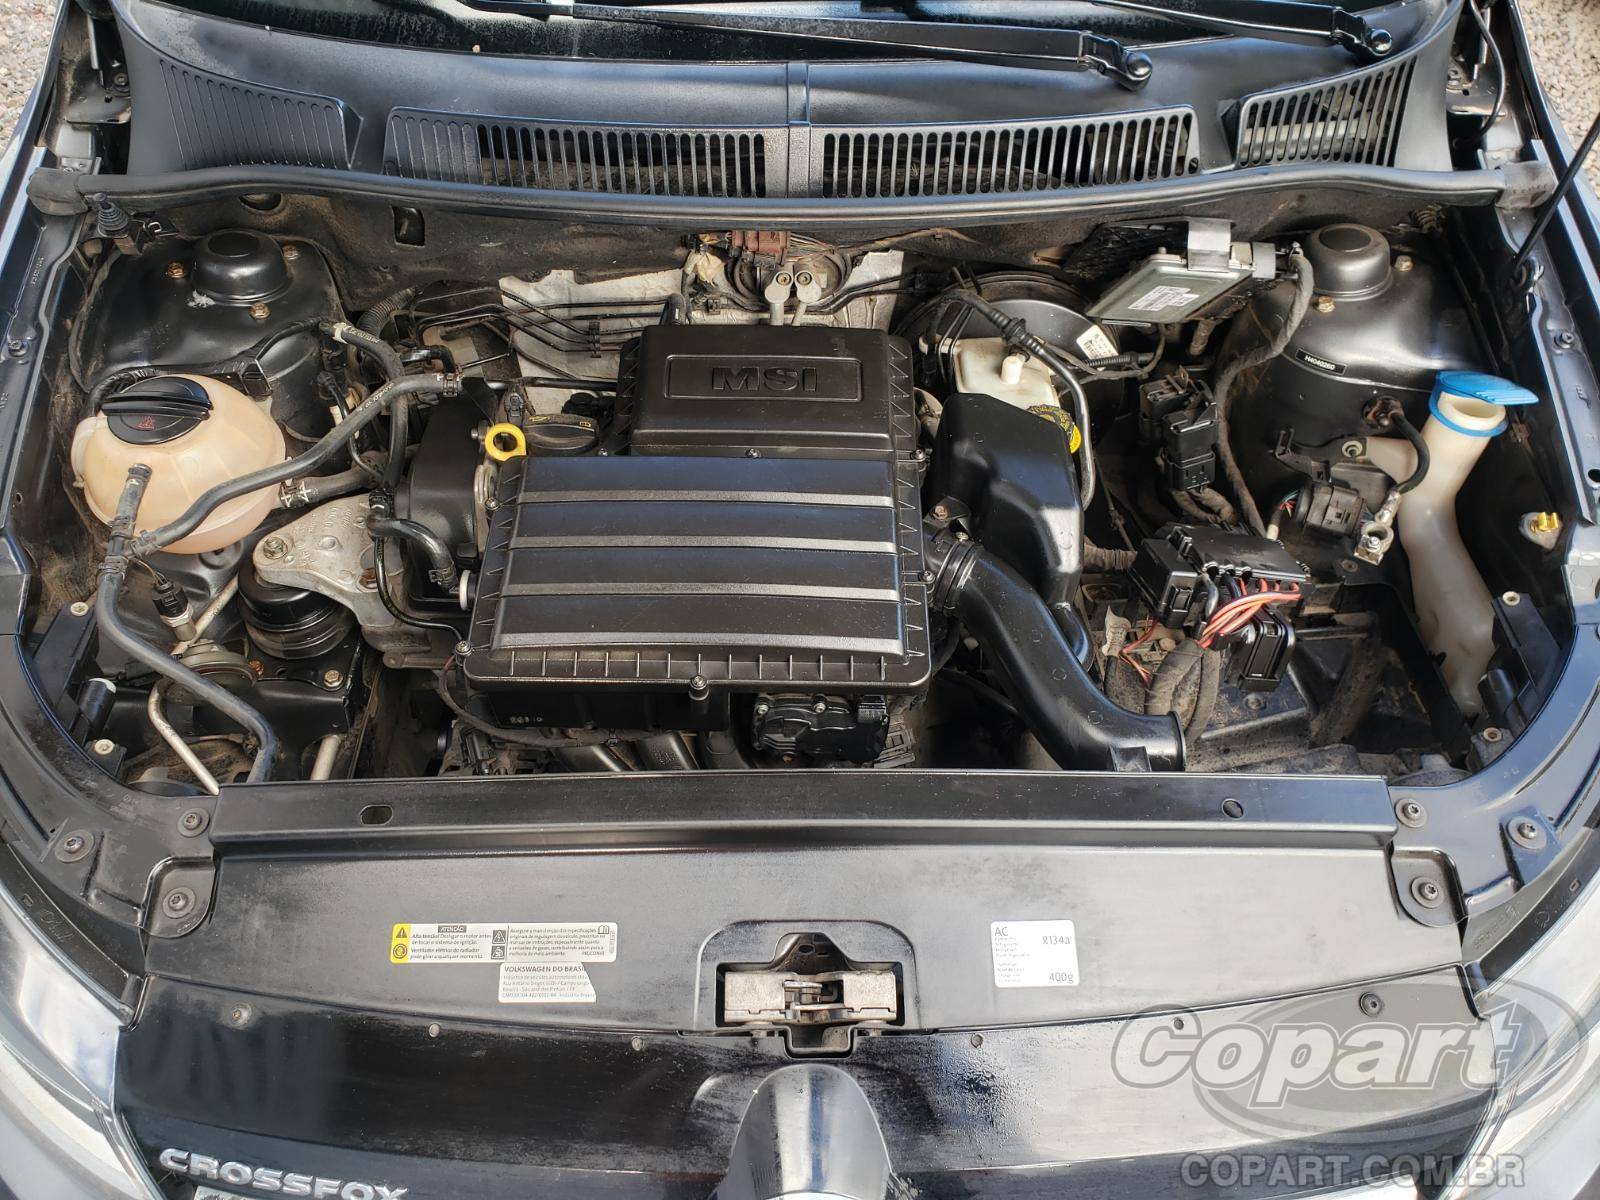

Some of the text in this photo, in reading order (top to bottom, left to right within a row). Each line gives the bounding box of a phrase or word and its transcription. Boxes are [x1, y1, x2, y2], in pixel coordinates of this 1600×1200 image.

[711, 366, 818, 391] MSI
[994, 927, 1008, 937] AC
[1042, 936, 1071, 944] R134a
[1049, 972, 1074, 984] 400g
[160, 1148, 408, 1200] CROSSFOX
